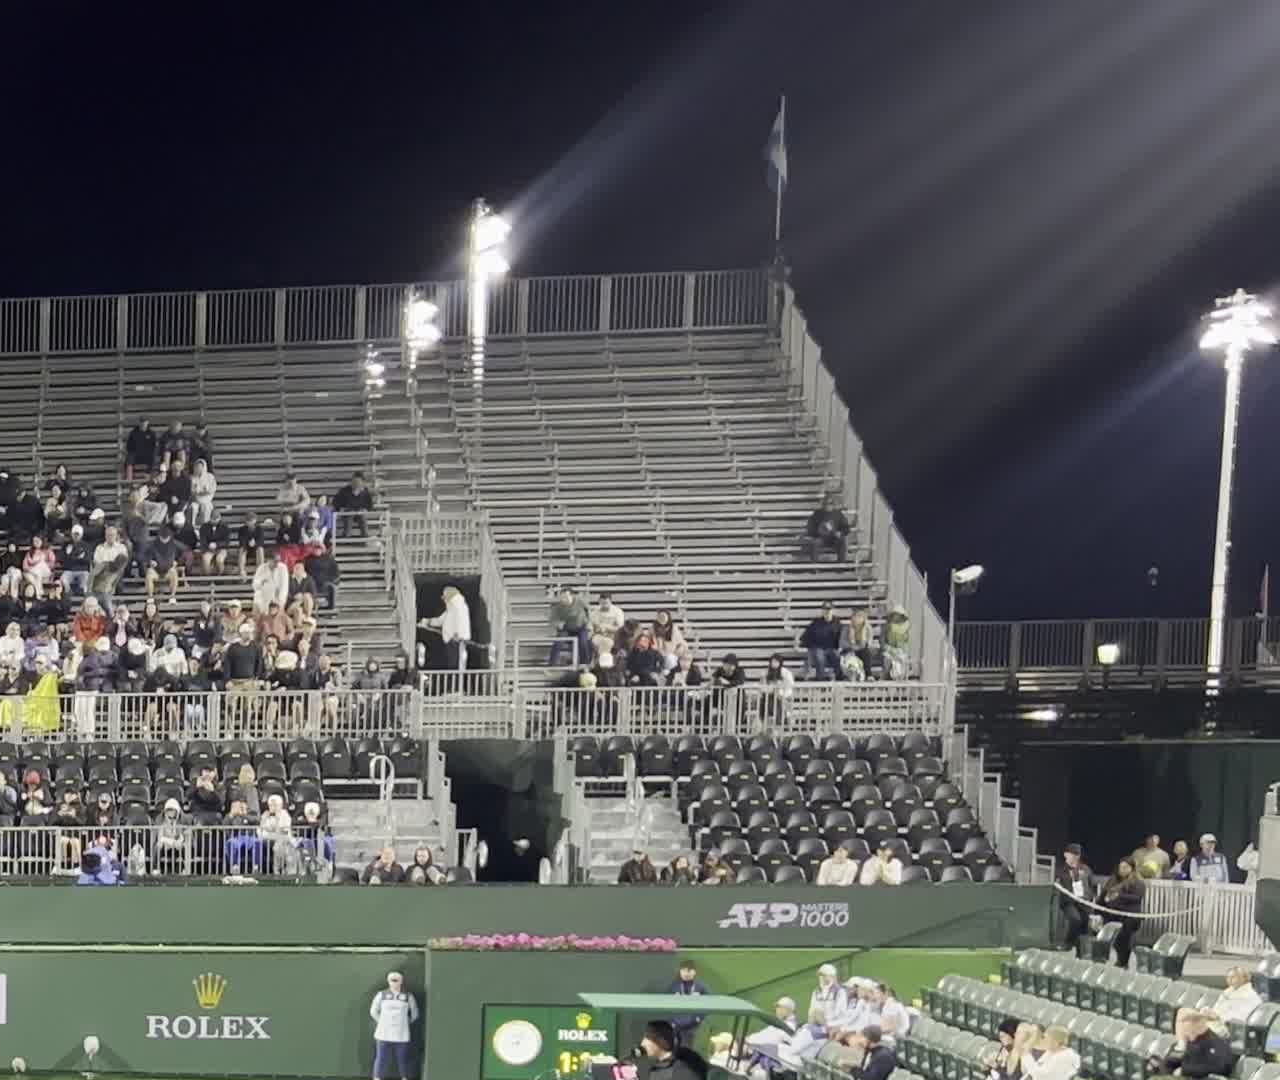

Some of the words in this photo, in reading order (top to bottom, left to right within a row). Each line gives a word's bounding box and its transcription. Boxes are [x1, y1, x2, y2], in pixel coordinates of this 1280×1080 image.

[800, 911, 850, 927] 1000
[145, 1015, 272, 1039] ROLEX
[558, 1029, 609, 1041] ROLEX
